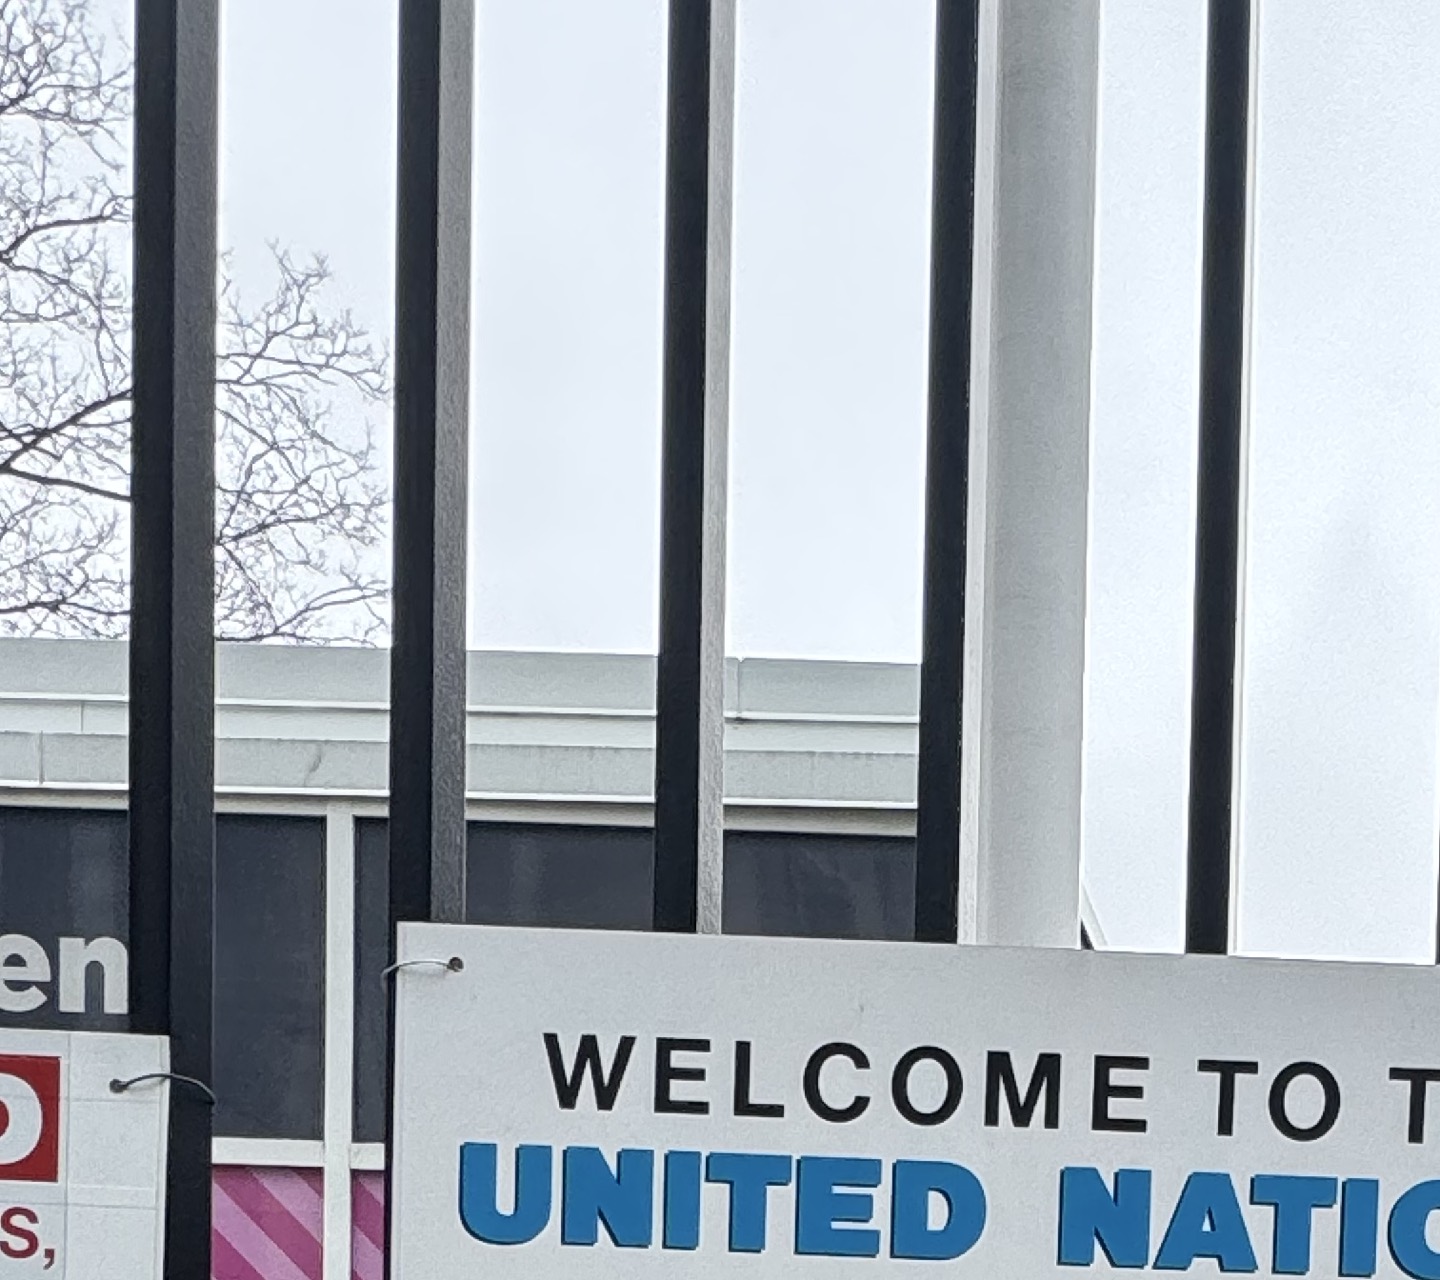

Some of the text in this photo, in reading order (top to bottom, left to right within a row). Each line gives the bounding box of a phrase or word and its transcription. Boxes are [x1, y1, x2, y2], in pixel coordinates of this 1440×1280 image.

[544, 1033, 1149, 1133] WELCOME
[1198, 1060, 1340, 1141] TO
[457, 1142, 987, 1261] UNITED
